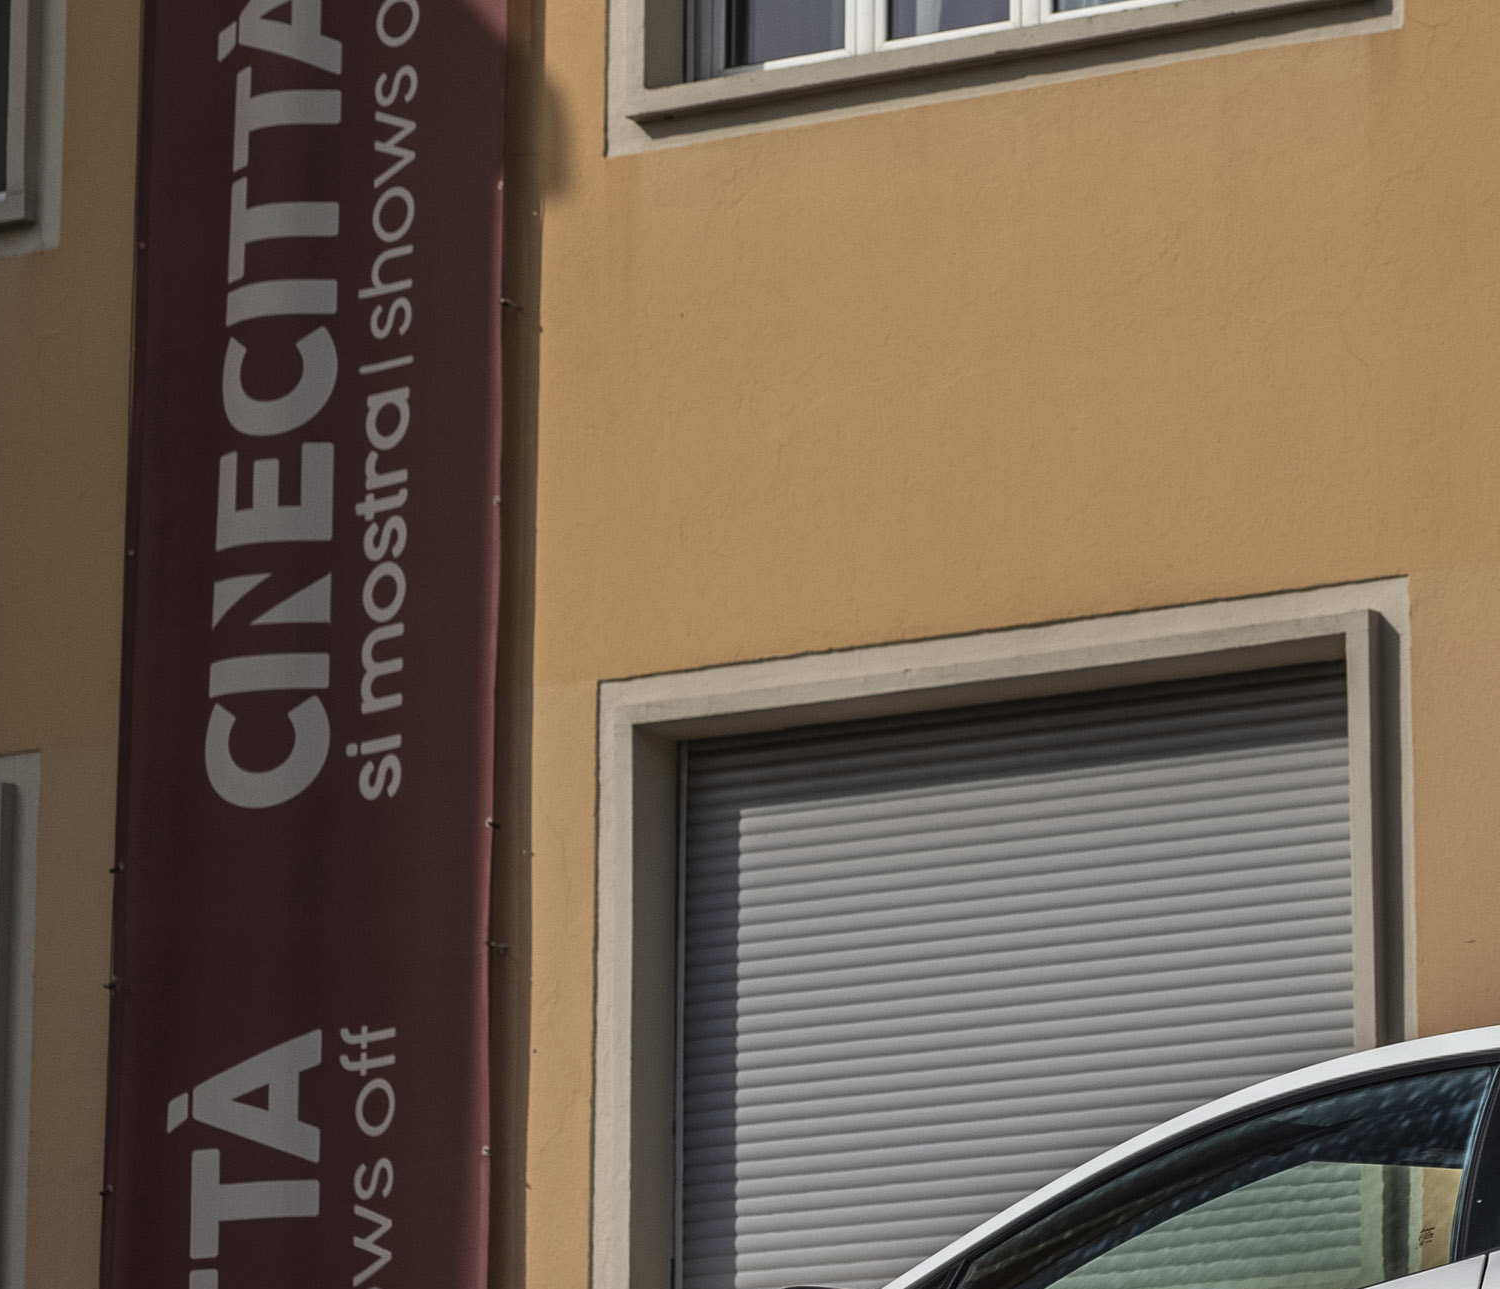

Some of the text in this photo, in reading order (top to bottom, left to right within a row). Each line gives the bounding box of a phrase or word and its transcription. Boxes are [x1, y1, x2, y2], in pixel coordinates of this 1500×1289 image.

[357, 64, 419, 340] shows
[354, 386, 411, 715] mostra
[345, 733, 403, 801] si
[339, 1025, 397, 1137] off
